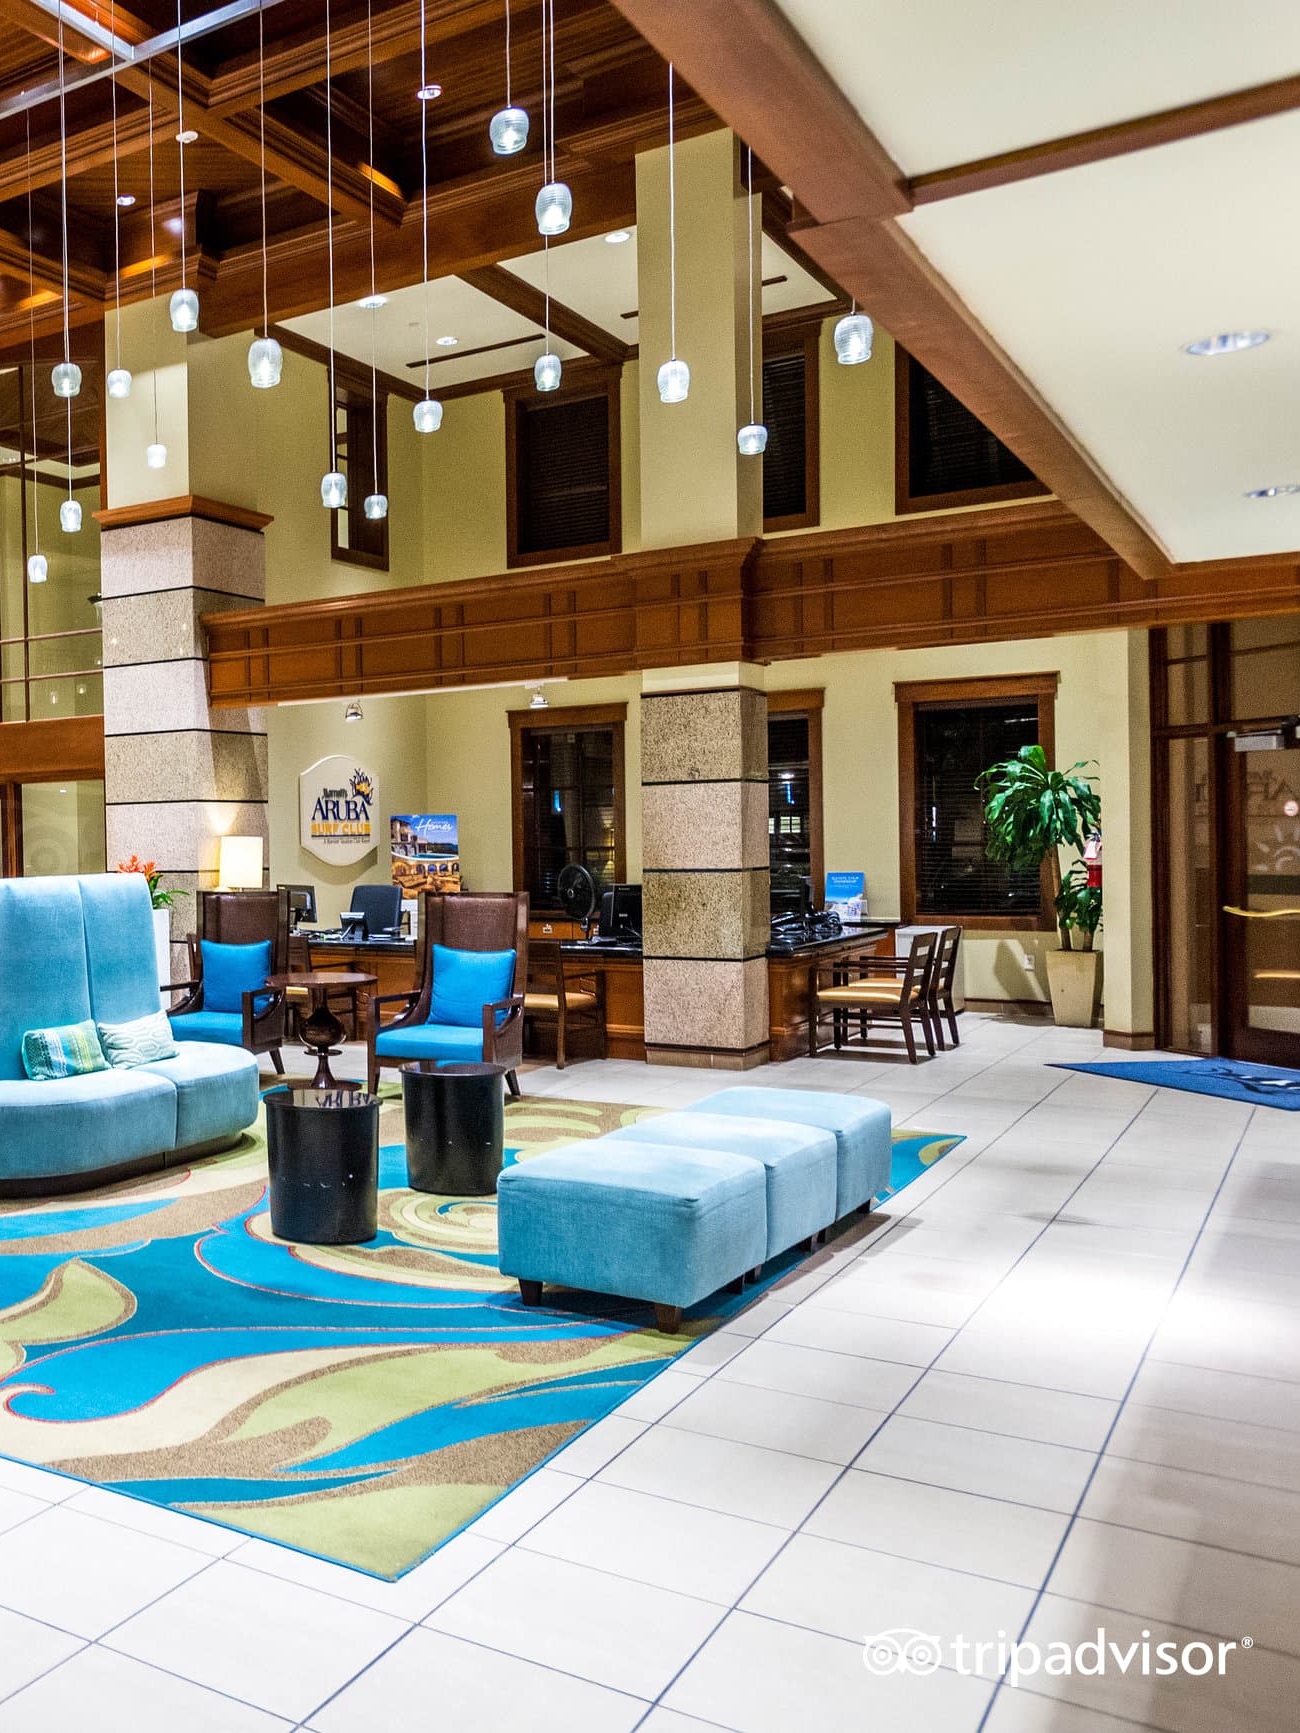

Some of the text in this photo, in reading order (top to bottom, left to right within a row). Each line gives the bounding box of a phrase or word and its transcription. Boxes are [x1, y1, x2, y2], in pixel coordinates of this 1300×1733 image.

[311, 797, 369, 821] ARUBA
[311, 822, 371, 835] SURF CLUB
